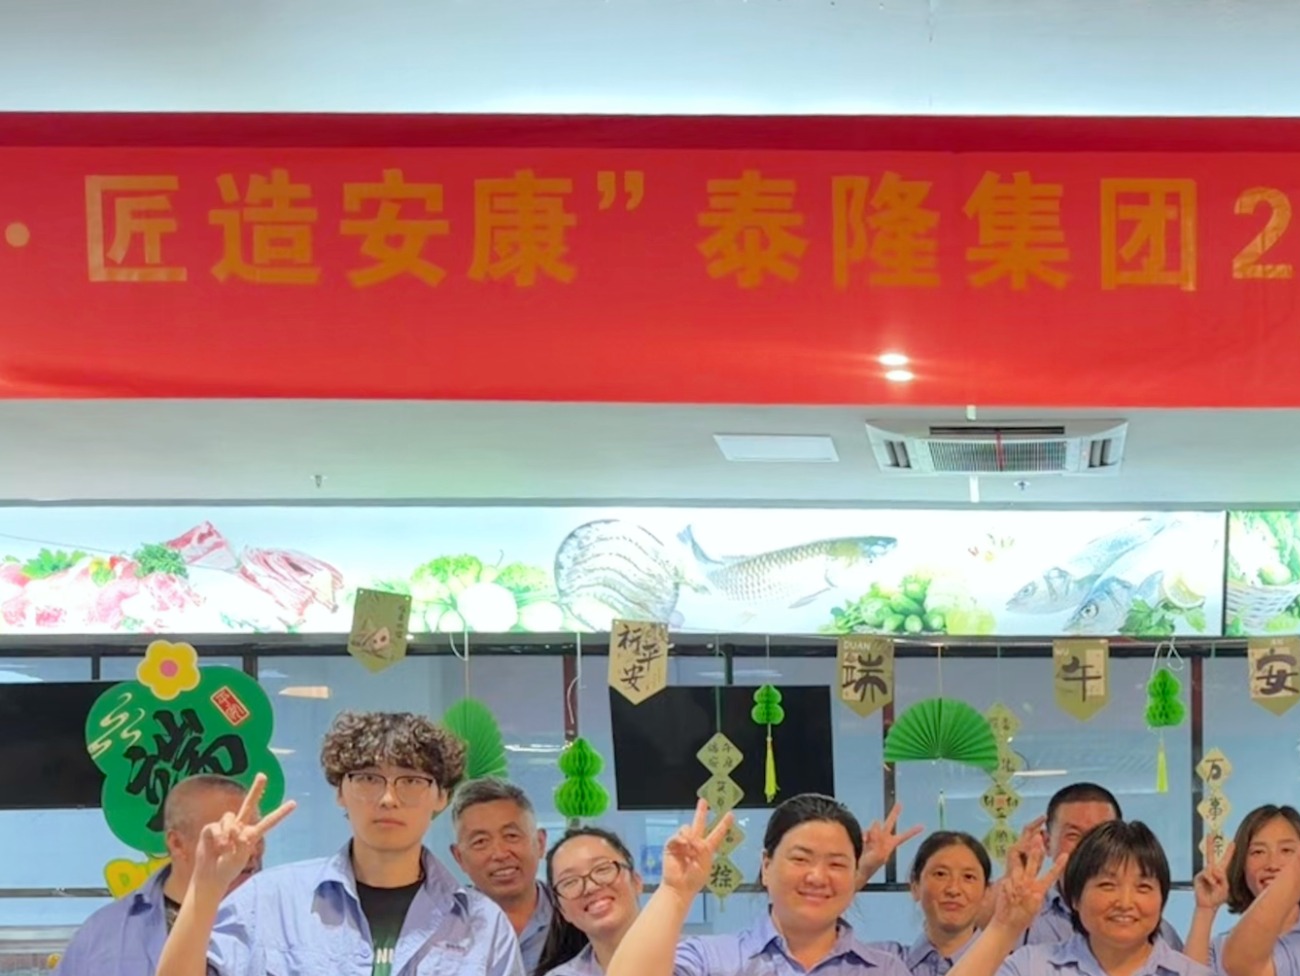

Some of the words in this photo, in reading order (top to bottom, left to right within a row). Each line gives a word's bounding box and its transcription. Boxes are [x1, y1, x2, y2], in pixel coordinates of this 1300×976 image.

[844, 641, 871, 651] DUAN
[1062, 656, 1101, 702] 午
[1255, 647, 1300, 695] 安
